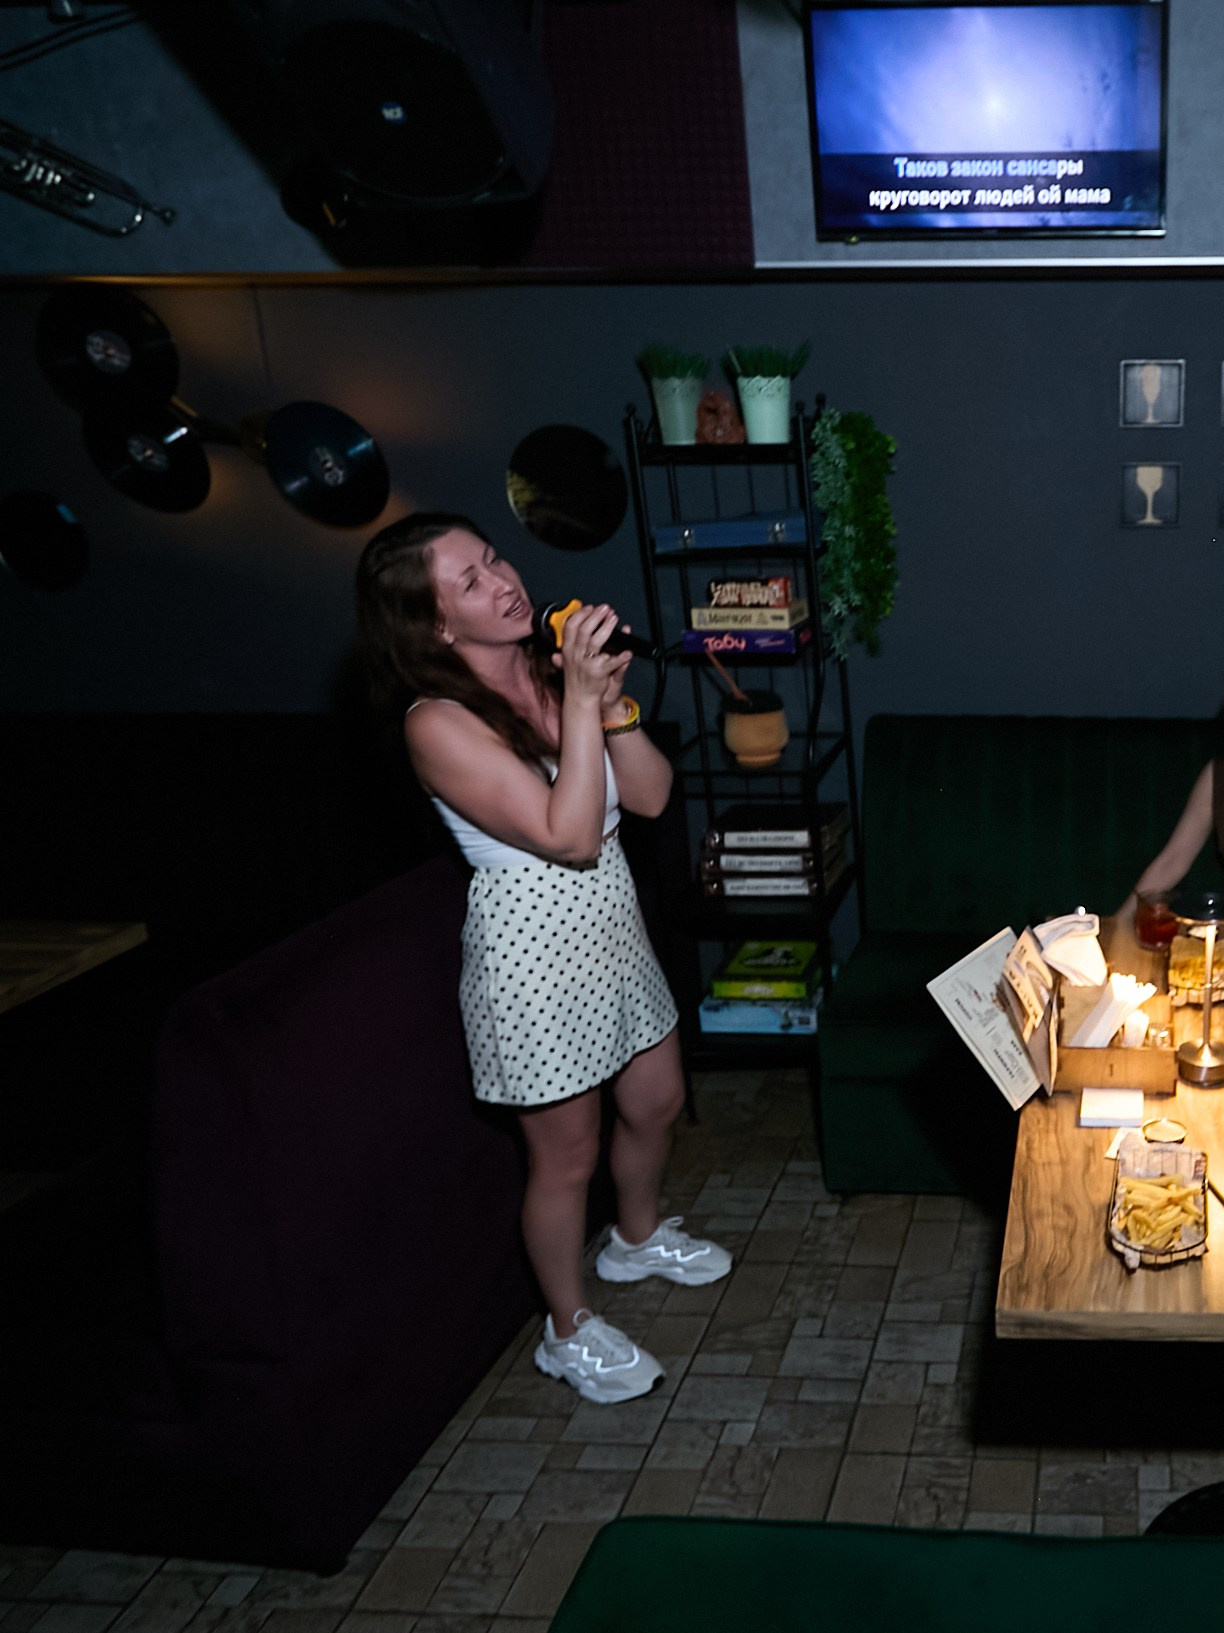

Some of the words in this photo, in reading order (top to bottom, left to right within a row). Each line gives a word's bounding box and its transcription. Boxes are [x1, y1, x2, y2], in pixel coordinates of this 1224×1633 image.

[893, 157, 949, 178] Таков
[951, 160, 1004, 177] закон
[1006, 158, 1084, 180] сансары
[869, 187, 971, 211] круговорот
[974, 184, 1035, 207] людей
[1038, 184, 1062, 205] ой
[1065, 187, 1112, 204] мама
